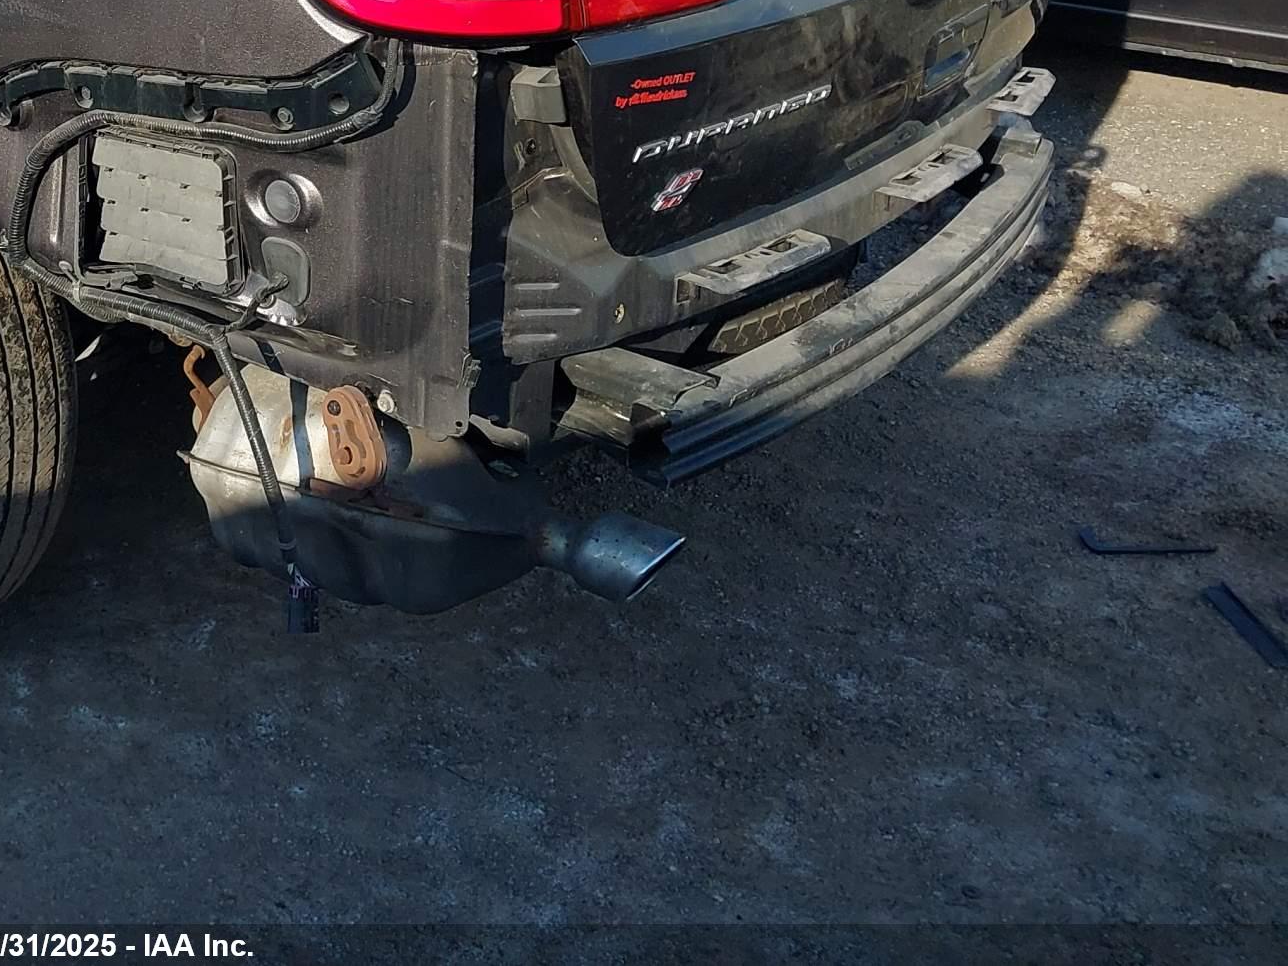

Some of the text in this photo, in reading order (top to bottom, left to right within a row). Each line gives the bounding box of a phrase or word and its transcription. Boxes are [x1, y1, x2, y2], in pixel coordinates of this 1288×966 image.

[663, 71, 697, 86] OUTLET
[615, 96, 628, 109] by
[632, 84, 833, 163] DURANGO
